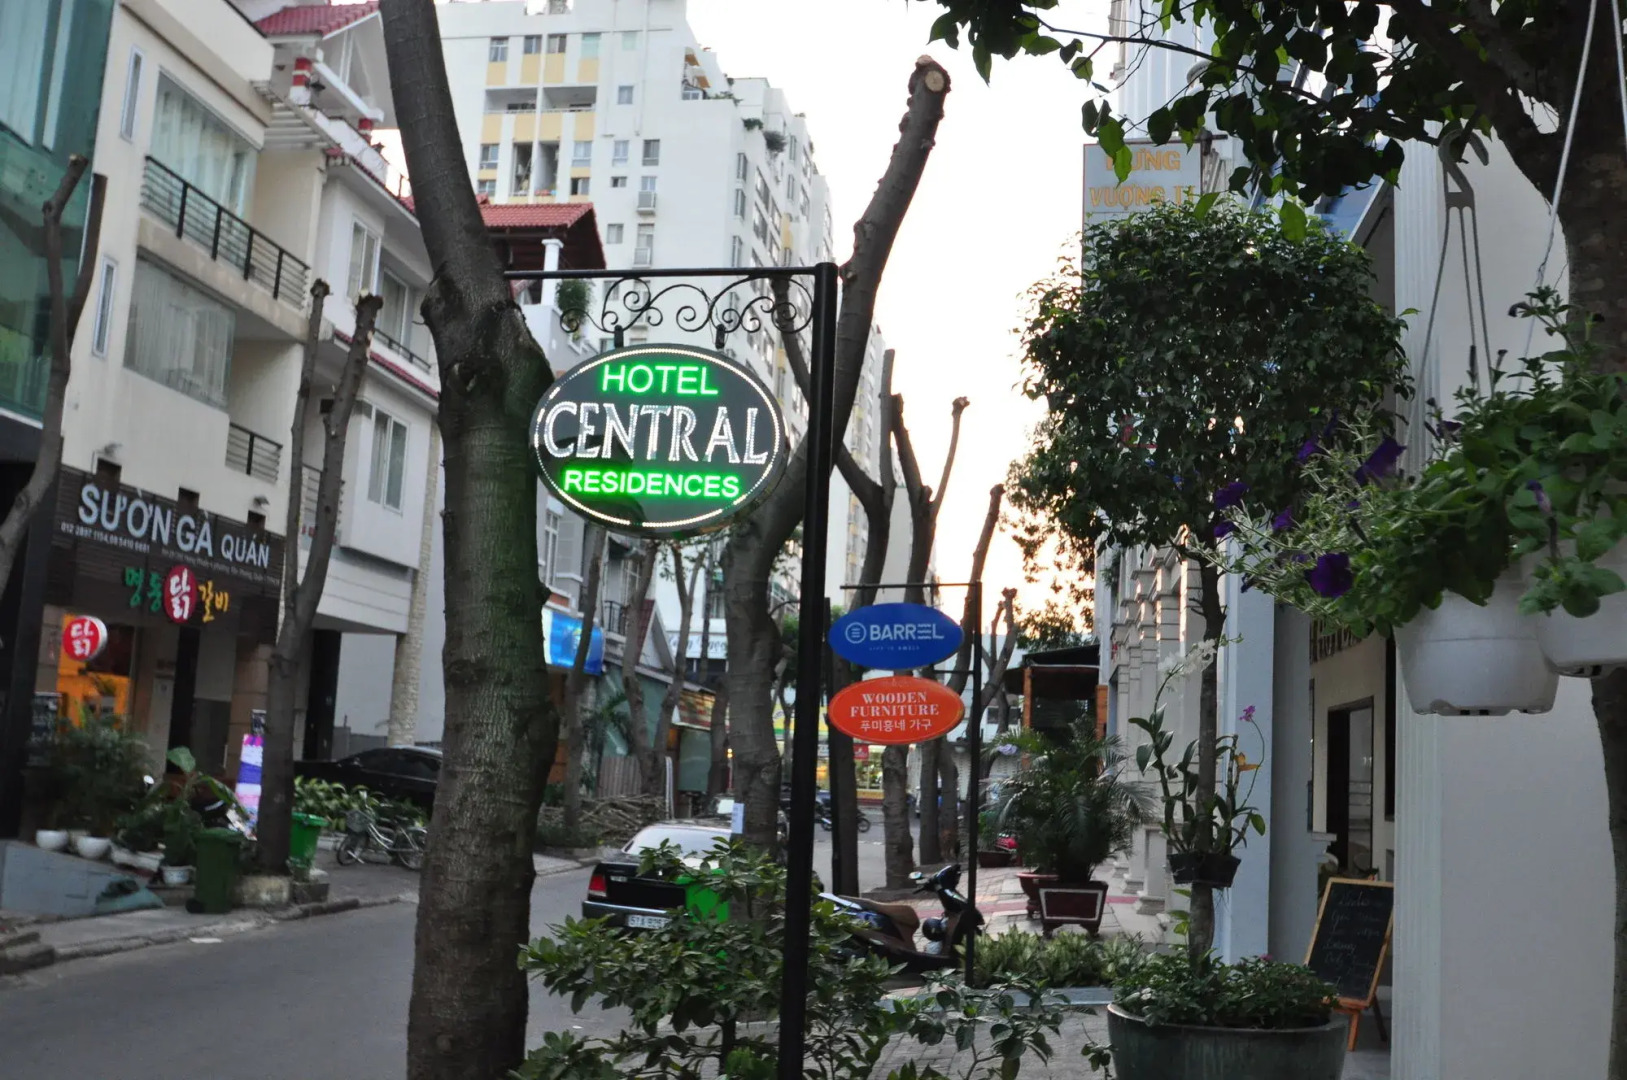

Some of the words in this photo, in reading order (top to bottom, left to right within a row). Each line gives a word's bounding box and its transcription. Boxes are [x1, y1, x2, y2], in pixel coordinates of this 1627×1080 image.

[602, 365, 718, 395] HOTEL
[544, 401, 769, 465] CENTRAL
[564, 470, 740, 497] RESIDENCES
[78, 483, 172, 546] SƯỜN
[176, 511, 213, 557] GÀ
[221, 533, 270, 568] QUÁN
[870, 623, 945, 641] BARREL
[862, 691, 927, 704] WOODEN
[850, 704, 939, 718] FURNITURE
[909, 718, 933, 731] 가구
